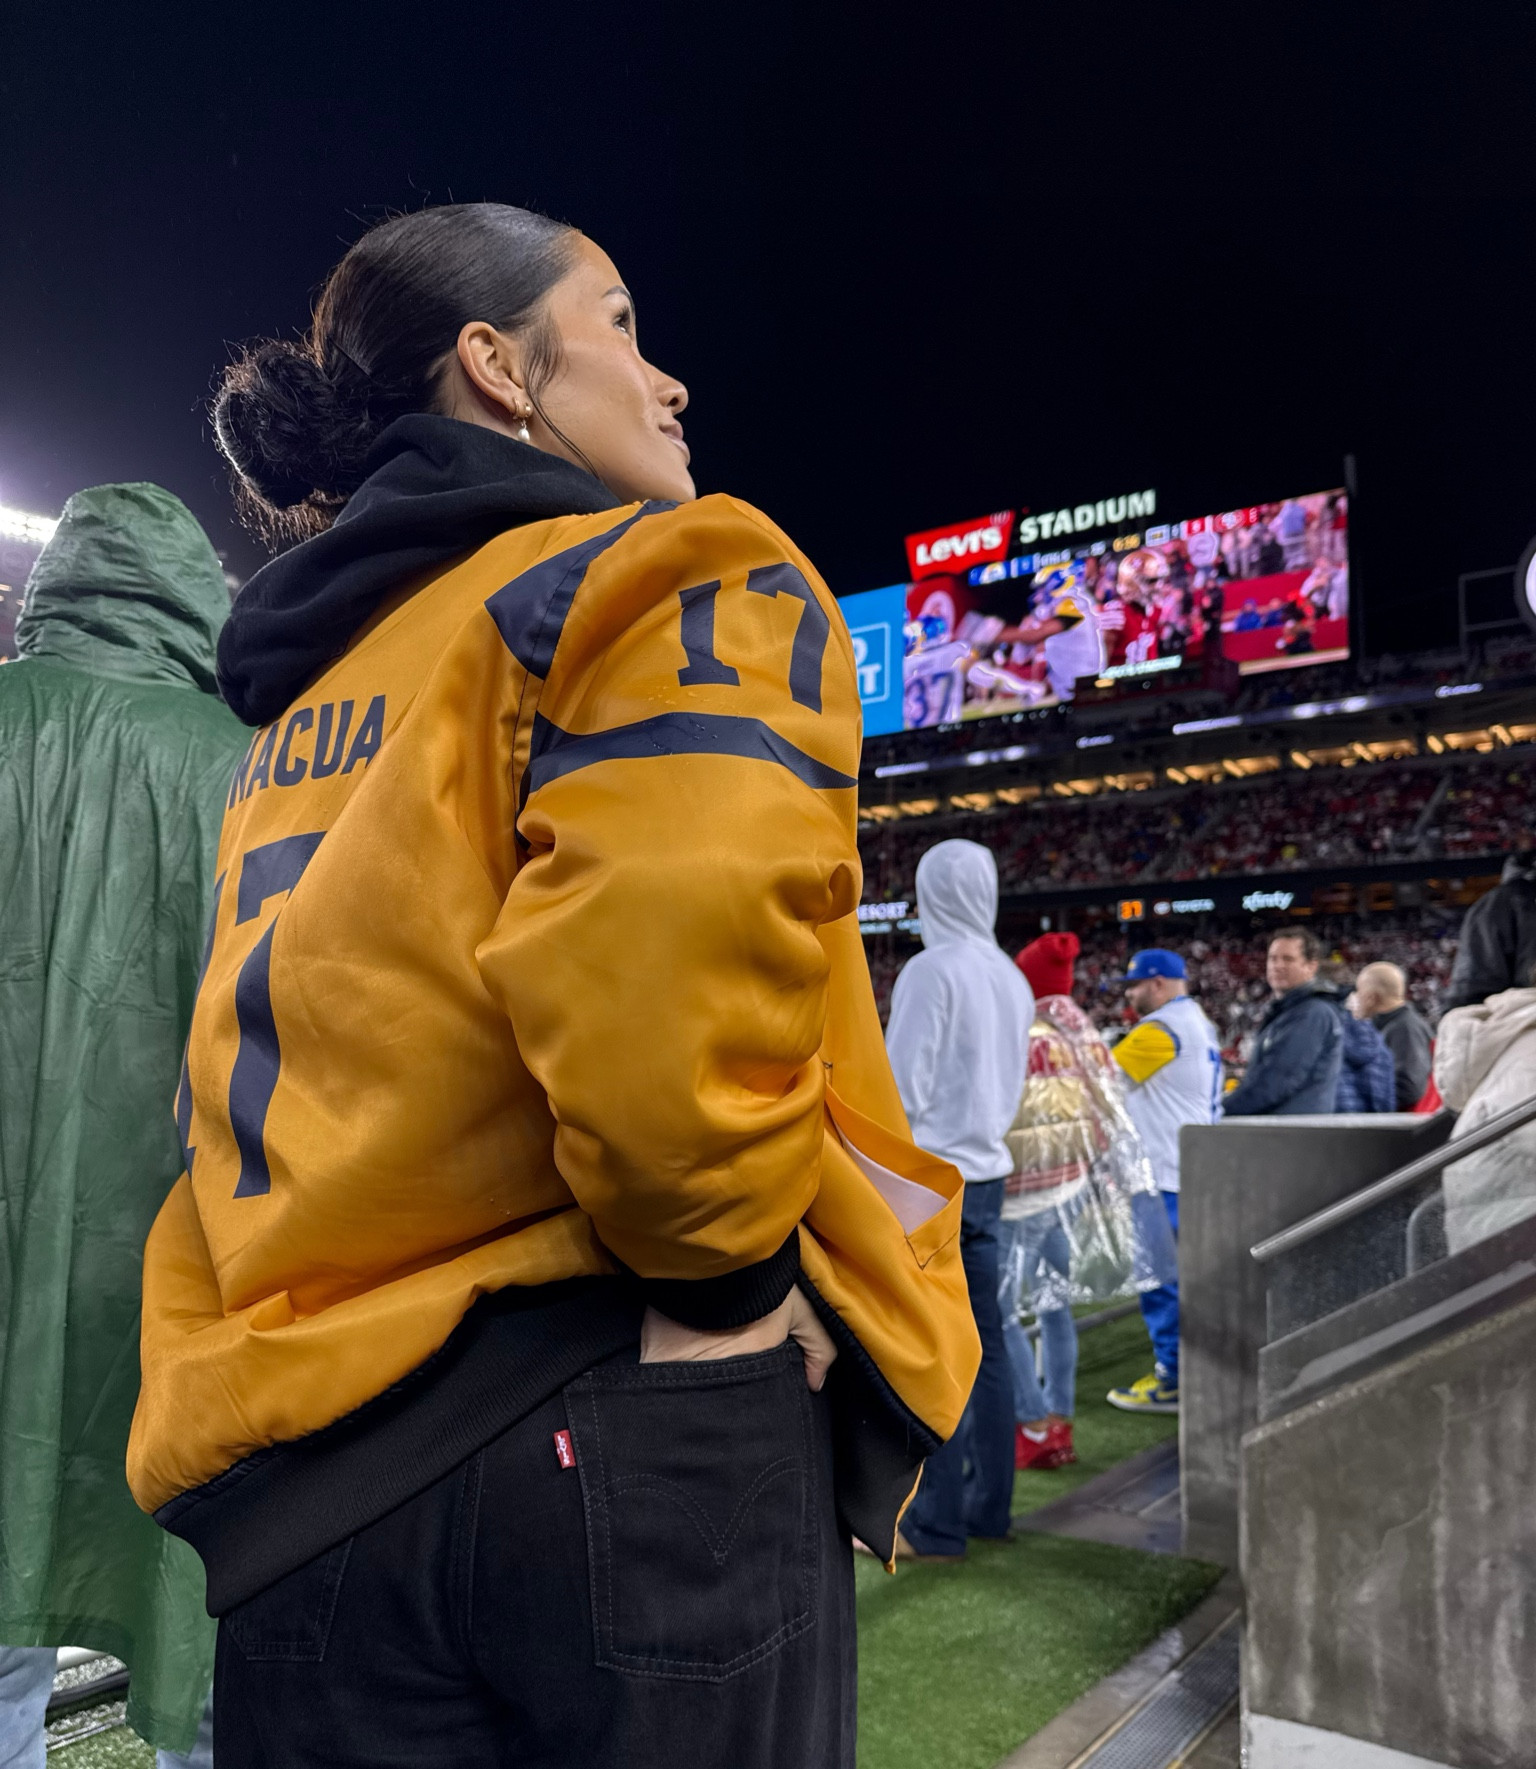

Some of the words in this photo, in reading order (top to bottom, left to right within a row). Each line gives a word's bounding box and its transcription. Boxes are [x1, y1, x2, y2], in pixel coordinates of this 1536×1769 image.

[1019, 489, 1155, 544] STADIUM
[677, 562, 830, 715] 17
[228, 694, 386, 811] NACUA
[1242, 890, 1294, 912] xfinity
[175, 831, 328, 1200] 7
